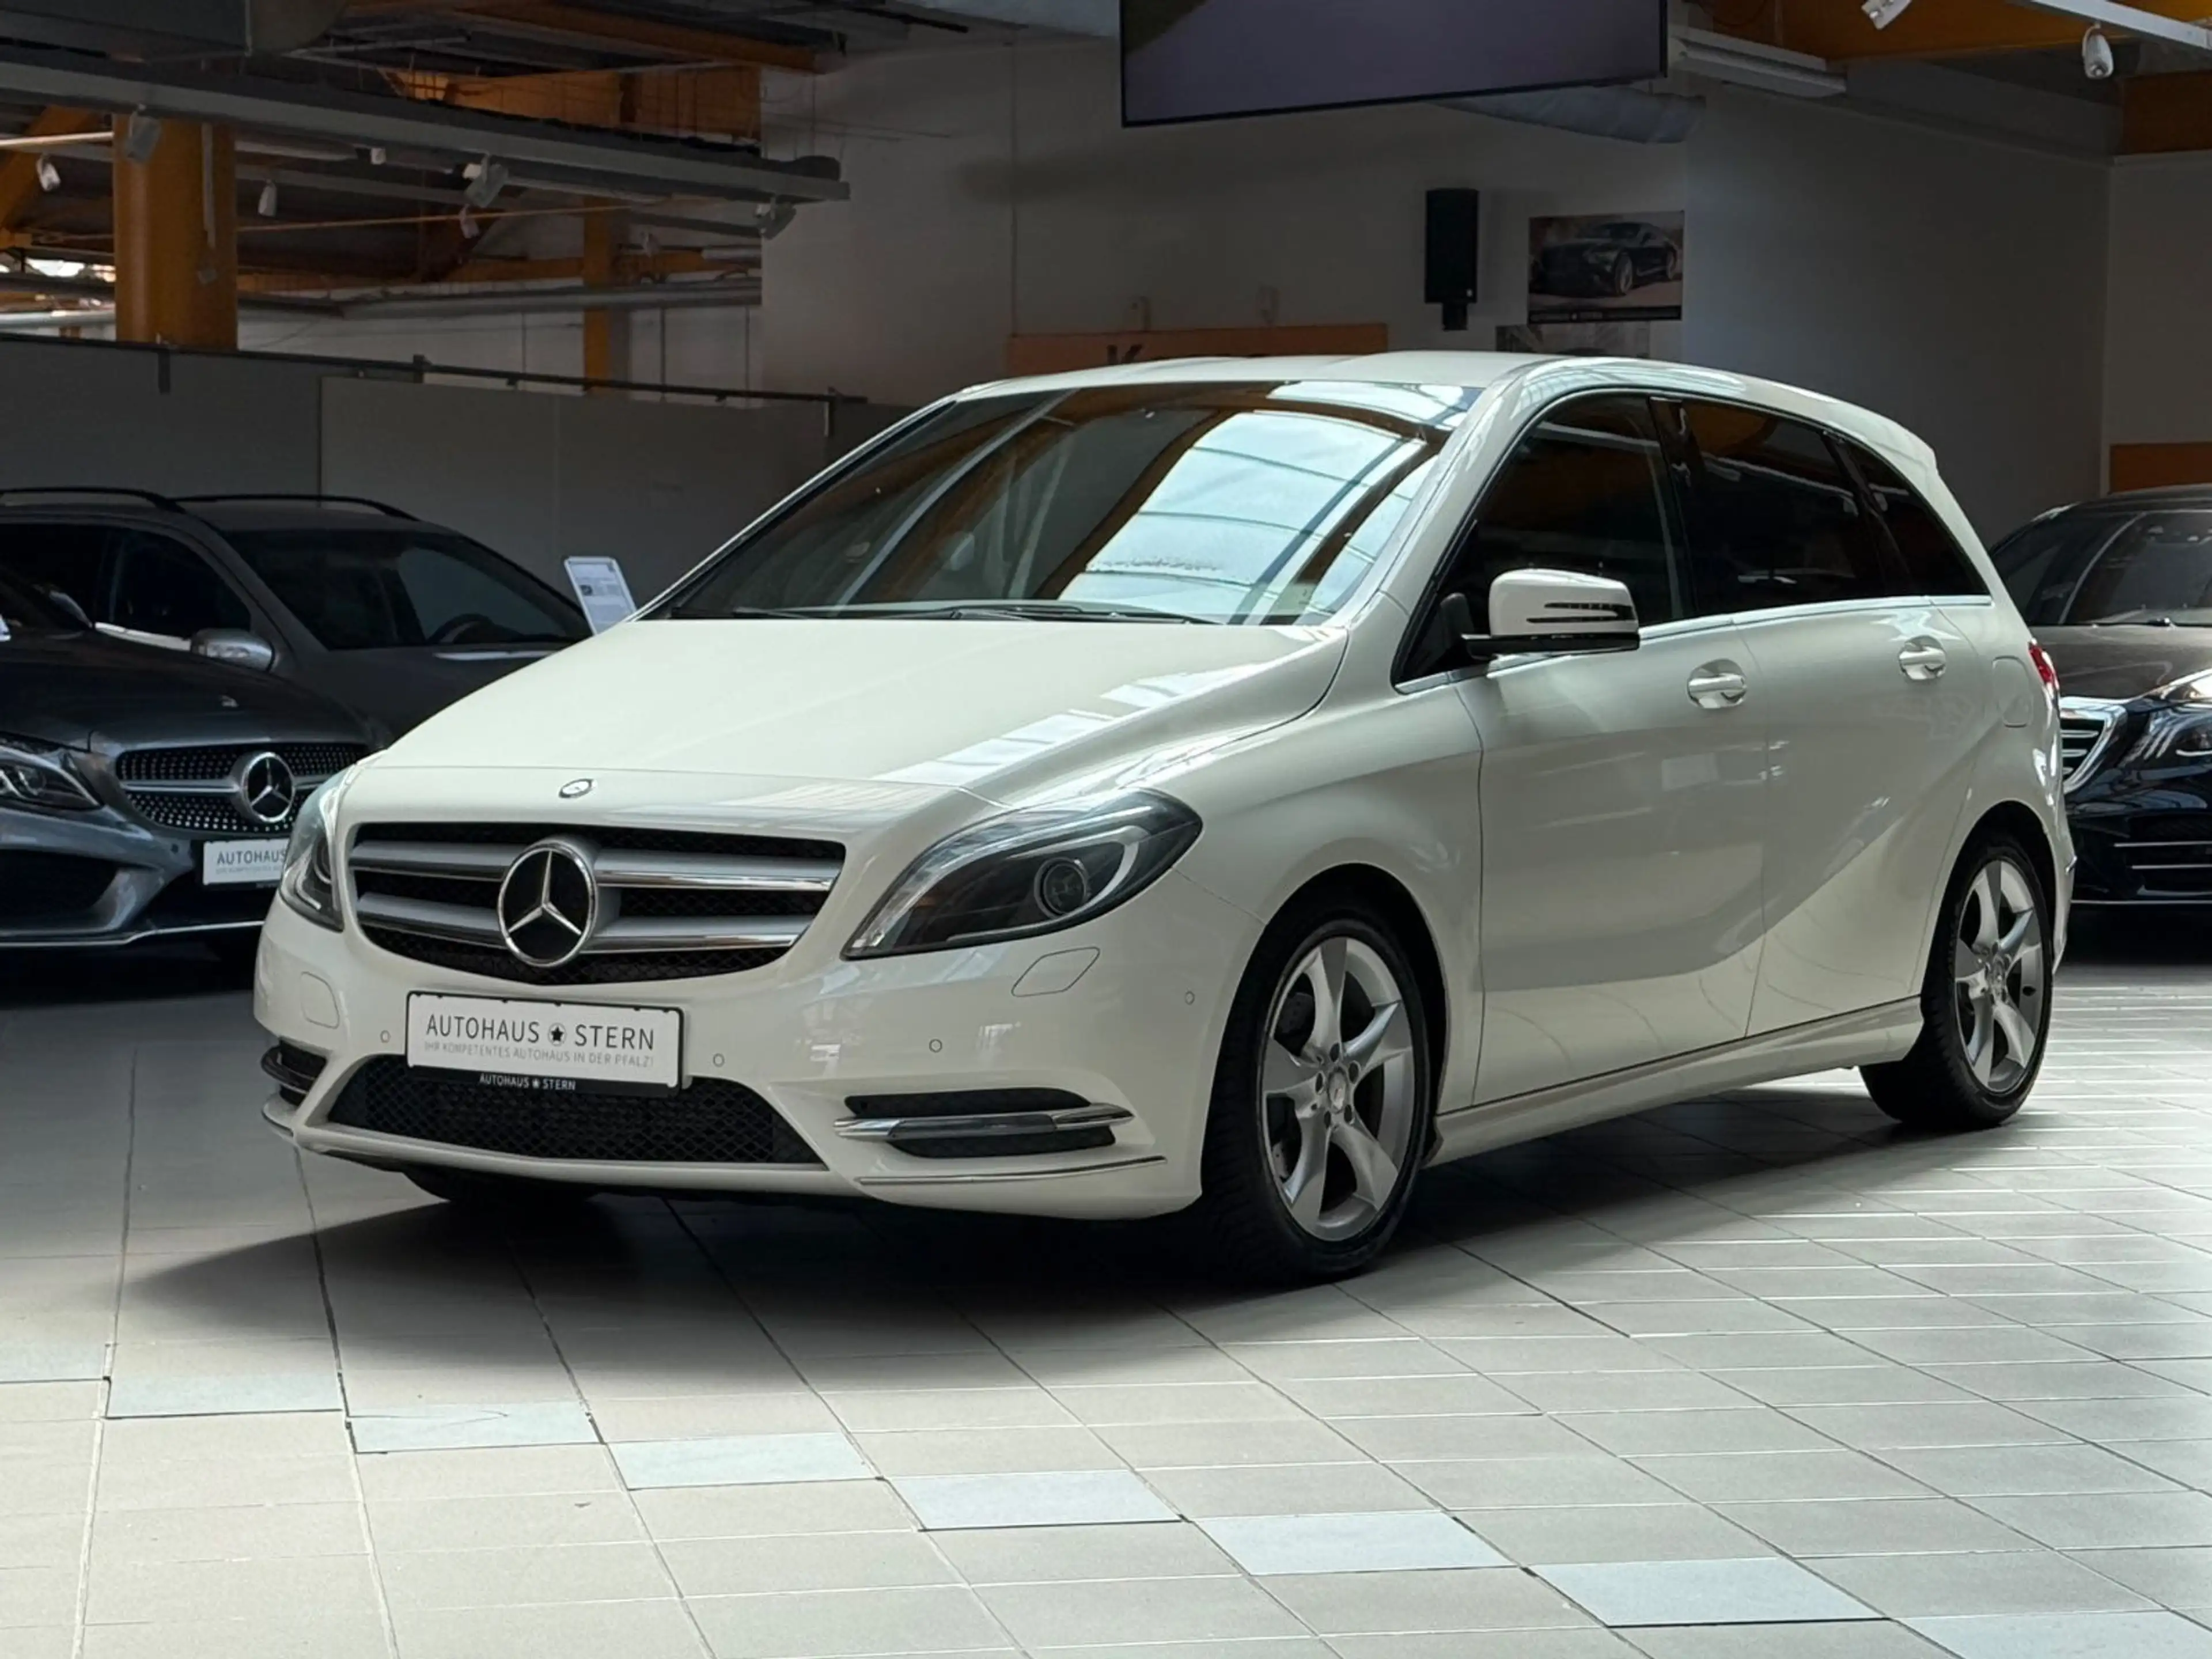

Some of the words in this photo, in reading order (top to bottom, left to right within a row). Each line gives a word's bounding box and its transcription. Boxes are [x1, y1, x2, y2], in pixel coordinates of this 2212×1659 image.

[426, 1013, 540, 1043] AUTOHAUS
[574, 1024, 654, 1051] STERN
[425, 1041, 440, 1052] IHR
[442, 1042, 510, 1059] KOMPETENTES
[513, 1047, 570, 1062] AUTOHAUS
[574, 1051, 585, 1063] IN
[589, 1052, 611, 1065] DER
[479, 1073, 529, 1088] AUTOHAUS
[542, 1077, 576, 1090] STERN
